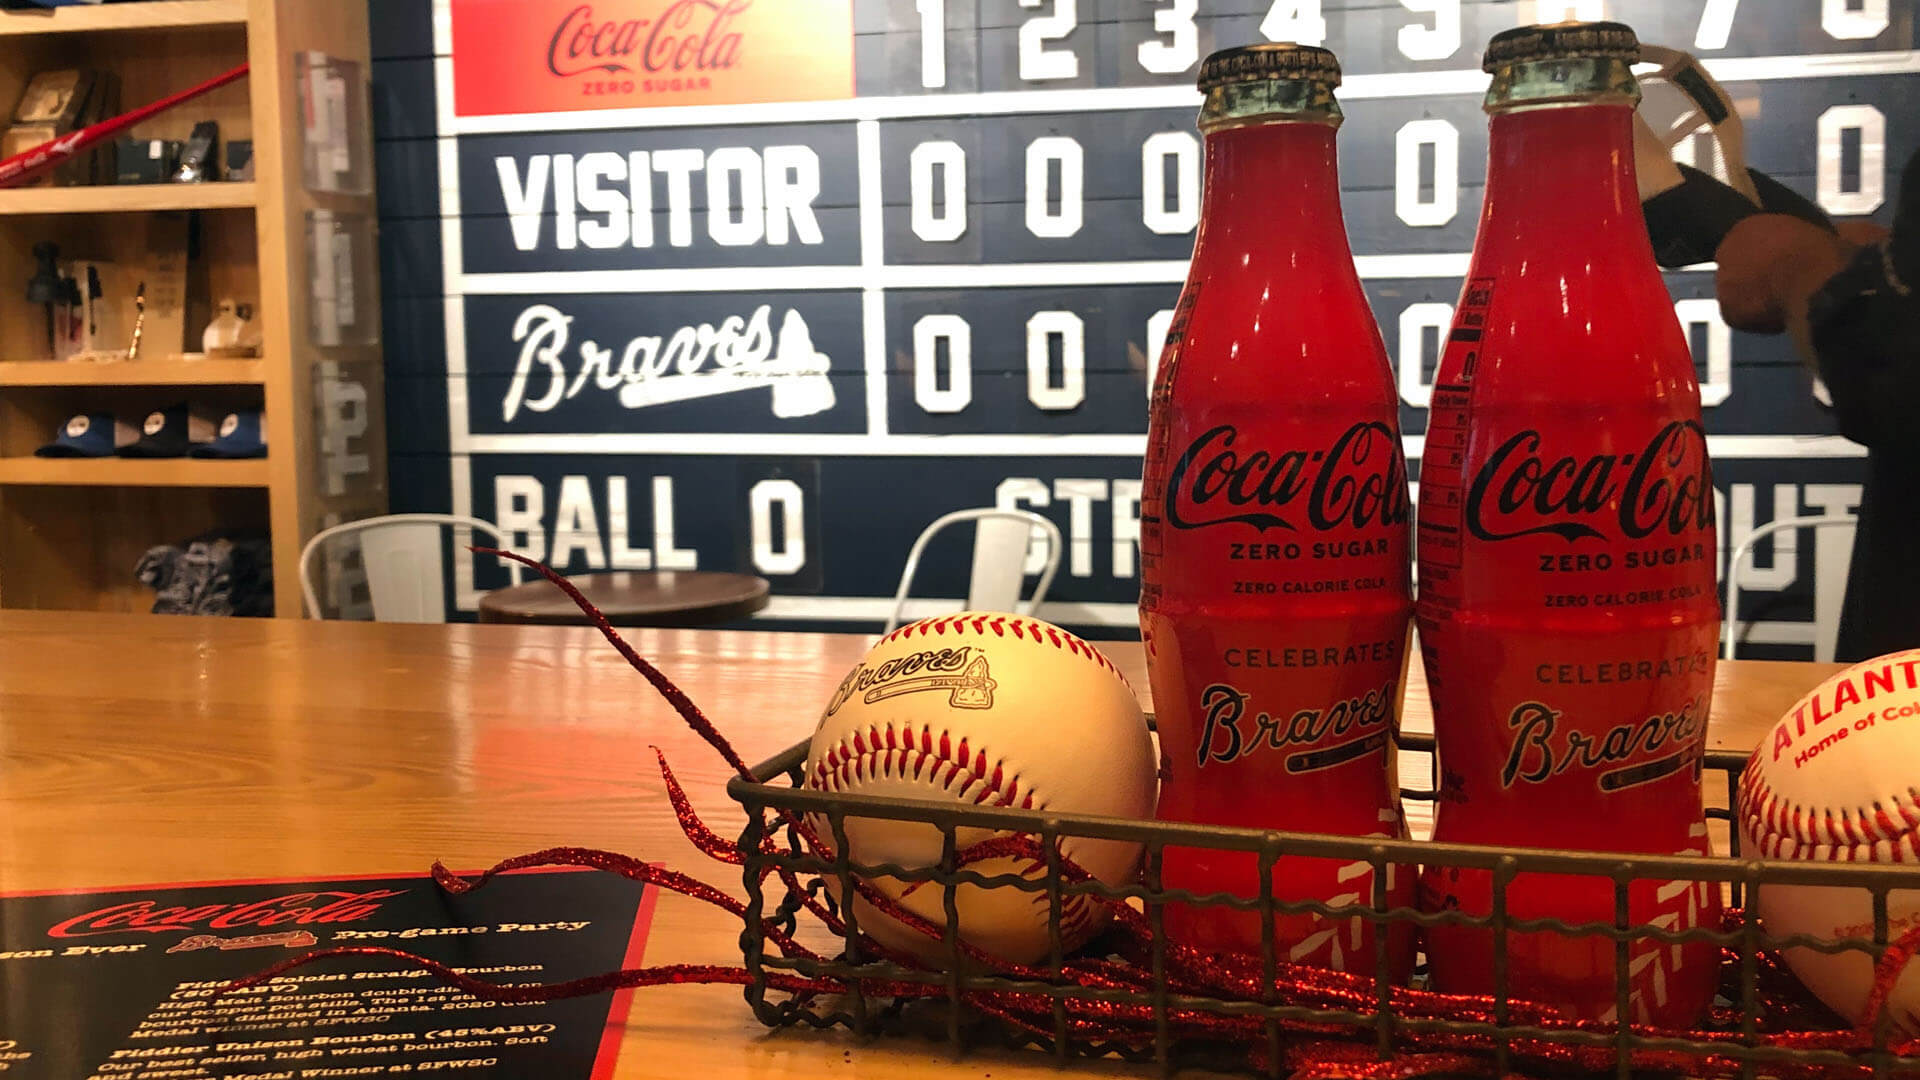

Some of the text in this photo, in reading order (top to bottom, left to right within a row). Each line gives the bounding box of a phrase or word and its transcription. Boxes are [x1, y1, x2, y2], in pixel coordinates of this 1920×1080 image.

[916, 0, 945, 88] 1
[1019, 0, 1078, 80] 2
[1138, 0, 1198, 73] 3
[582, 77, 712, 96] ZERO SUGAR
[496, 145, 823, 251] VISITOR
[910, 141, 967, 242] 0
[1025, 137, 1084, 238] 0
[1143, 132, 1200, 234] 0
[1396, 120, 1459, 227] 0
[1817, 104, 1886, 215] 0
[504, 305, 772, 422] Braves
[914, 315, 972, 413] 0
[1027, 310, 1086, 411] 0
[1399, 303, 1455, 408] 0
[494, 475, 698, 571] BALL
[749, 479, 806, 574] 0
[1712, 483, 1864, 592] UT
[1230, 539, 1389, 560] ZERO SUGAR
[1539, 544, 1704, 572] ZERO SUGAR
[1234, 577, 1386, 594] ZERO CALORIE COLA
[1545, 594, 1589, 608] ZERO
[1593, 588, 1664, 607] CALORIE
[1224, 640, 1395, 668] CELEBRATES
[821, 646, 972, 722] Braves
[1197, 681, 1393, 768] Braves
[1501, 692, 1705, 790] Braves
[1794, 727, 1849, 769] Home
[1854, 711, 1876, 731] of
[48, 889, 411, 939] Coca-Cola
[61, 945, 147, 956] Ever
[331, 926, 488, 940] Pre-game
[496, 921, 591, 934] Party
[269, 974, 347, 985] Soloist
[450, 965, 543, 975] Bourbon
[139, 1016, 229, 1029] bourbon
[235, 1010, 320, 1022] distilled
[326, 1009, 346, 1017] in
[441, 1001, 496, 1011] 2020
[148, 1010, 187, 1019] our
[191, 1006, 265, 1018] copper
[268, 1003, 304, 1013] pot
[371, 997, 408, 1006] The
[157, 1001, 207, 1010] High
[214, 997, 262, 1006] Malt
[267, 992, 354, 1004] Bourbon
[129, 1028, 198, 1039] Medal
[205, 1023, 283, 1034] winner
[286, 1020, 309, 1028] at
[98, 1063, 143, 1072] Our
[146, 1058, 195, 1069] best
[273, 1049, 324, 1060] high
[330, 1045, 398, 1057] wheat
[403, 1039, 498, 1052] bourbon.
[505, 1036, 549, 1046] Soft
[110, 1046, 210, 1059] Fiddler
[216, 1039, 304, 1052] Unison
[309, 1033, 416, 1046] Bourbon
[301, 1066, 384, 1078] Winner
[388, 1064, 412, 1073] at
